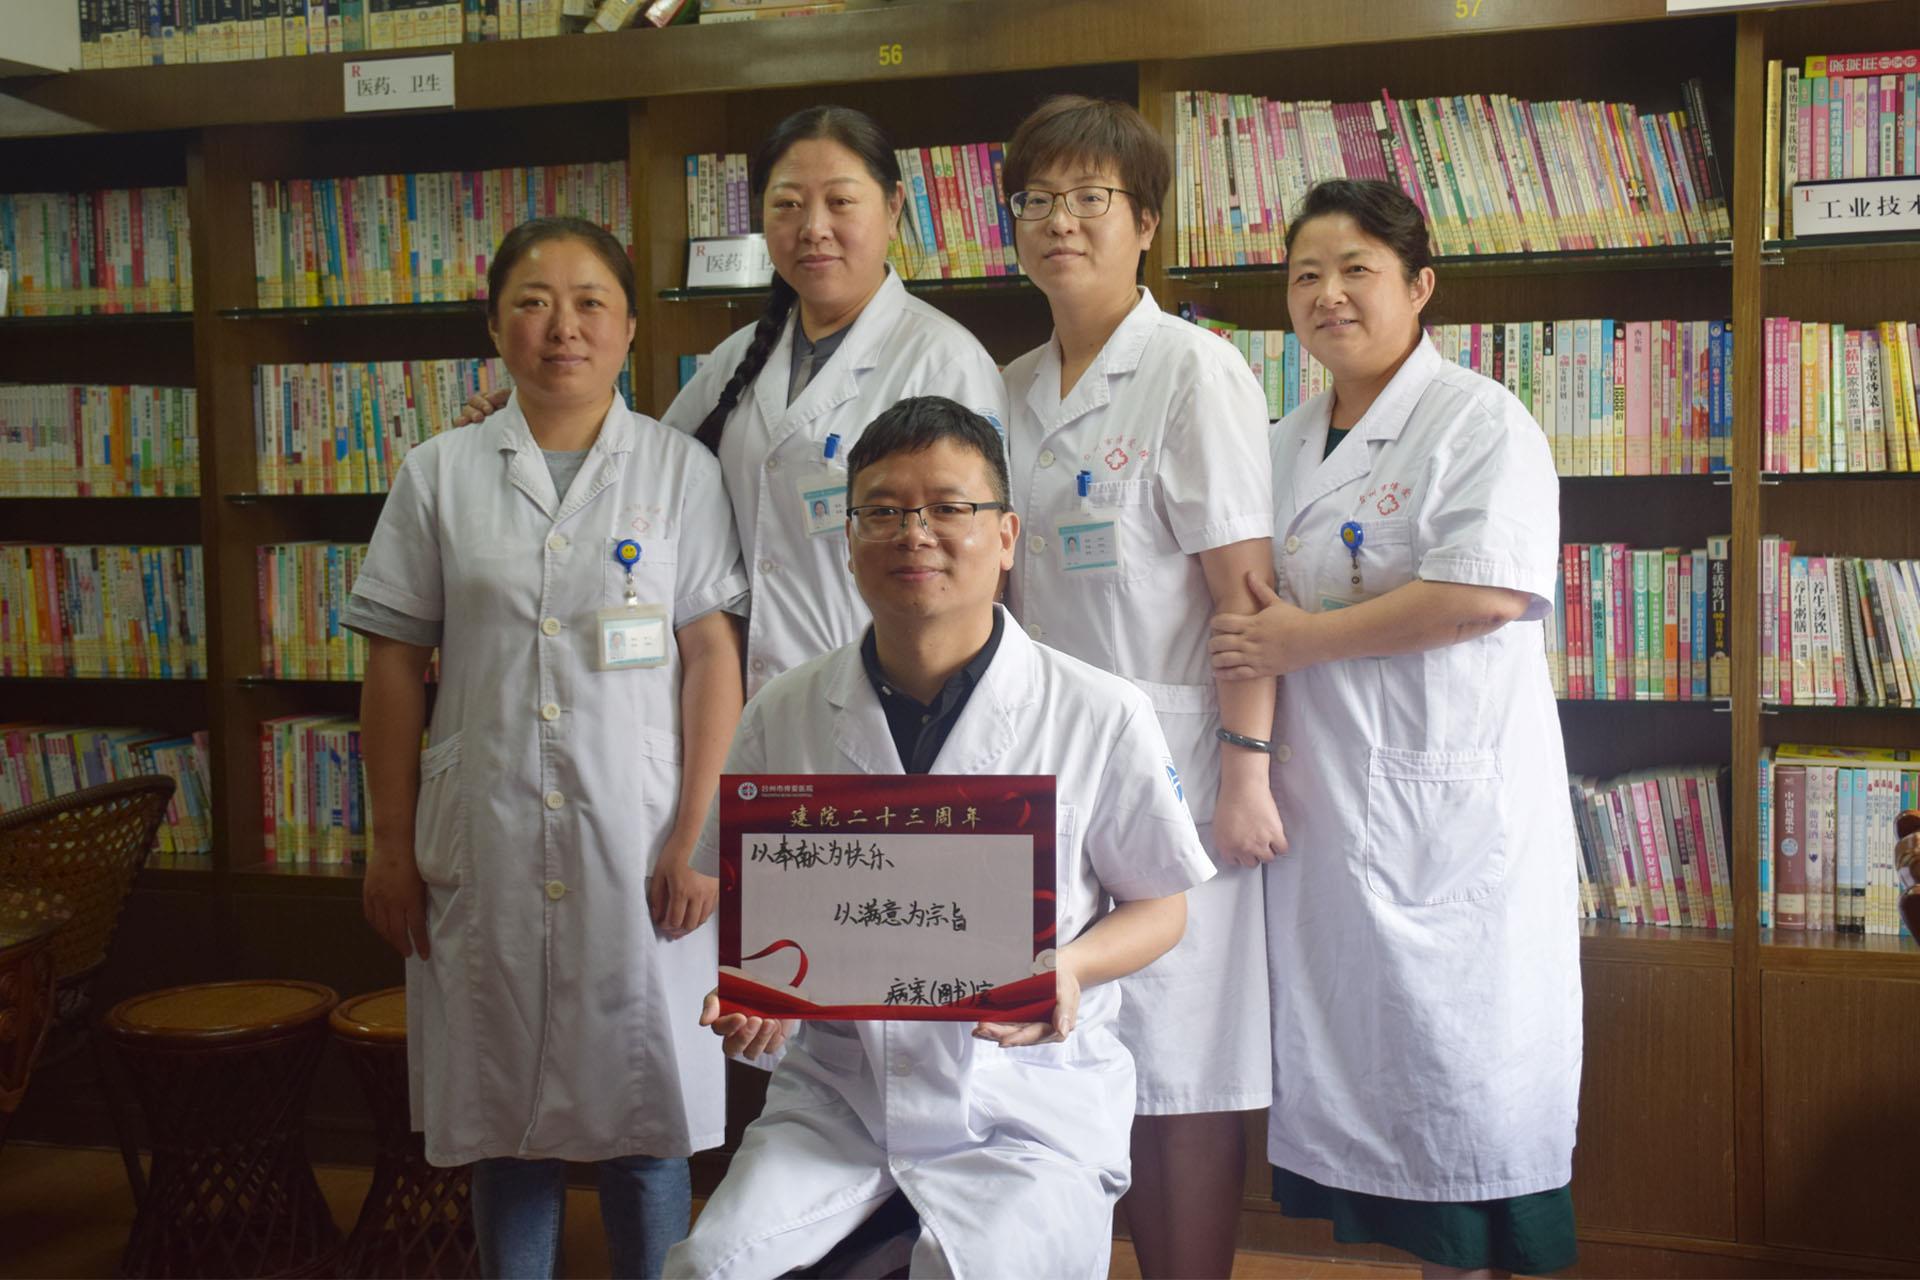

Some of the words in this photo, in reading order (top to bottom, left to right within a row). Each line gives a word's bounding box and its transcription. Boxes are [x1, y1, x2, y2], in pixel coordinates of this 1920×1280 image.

[1455, 0, 1482, 18] 57
[879, 44, 903, 66] 56
[351, 65, 361, 78] R
[357, 74, 441, 97] 医药、卫生
[1801, 189, 1814, 202] T
[697, 245, 706, 257] R
[1713, 562, 1725, 611] 生活窍门
[790, 805, 982, 830] 建院二十三周年
[751, 835, 895, 872] 以奉献为快乐
[833, 898, 967, 932] 以满意为宗旨
